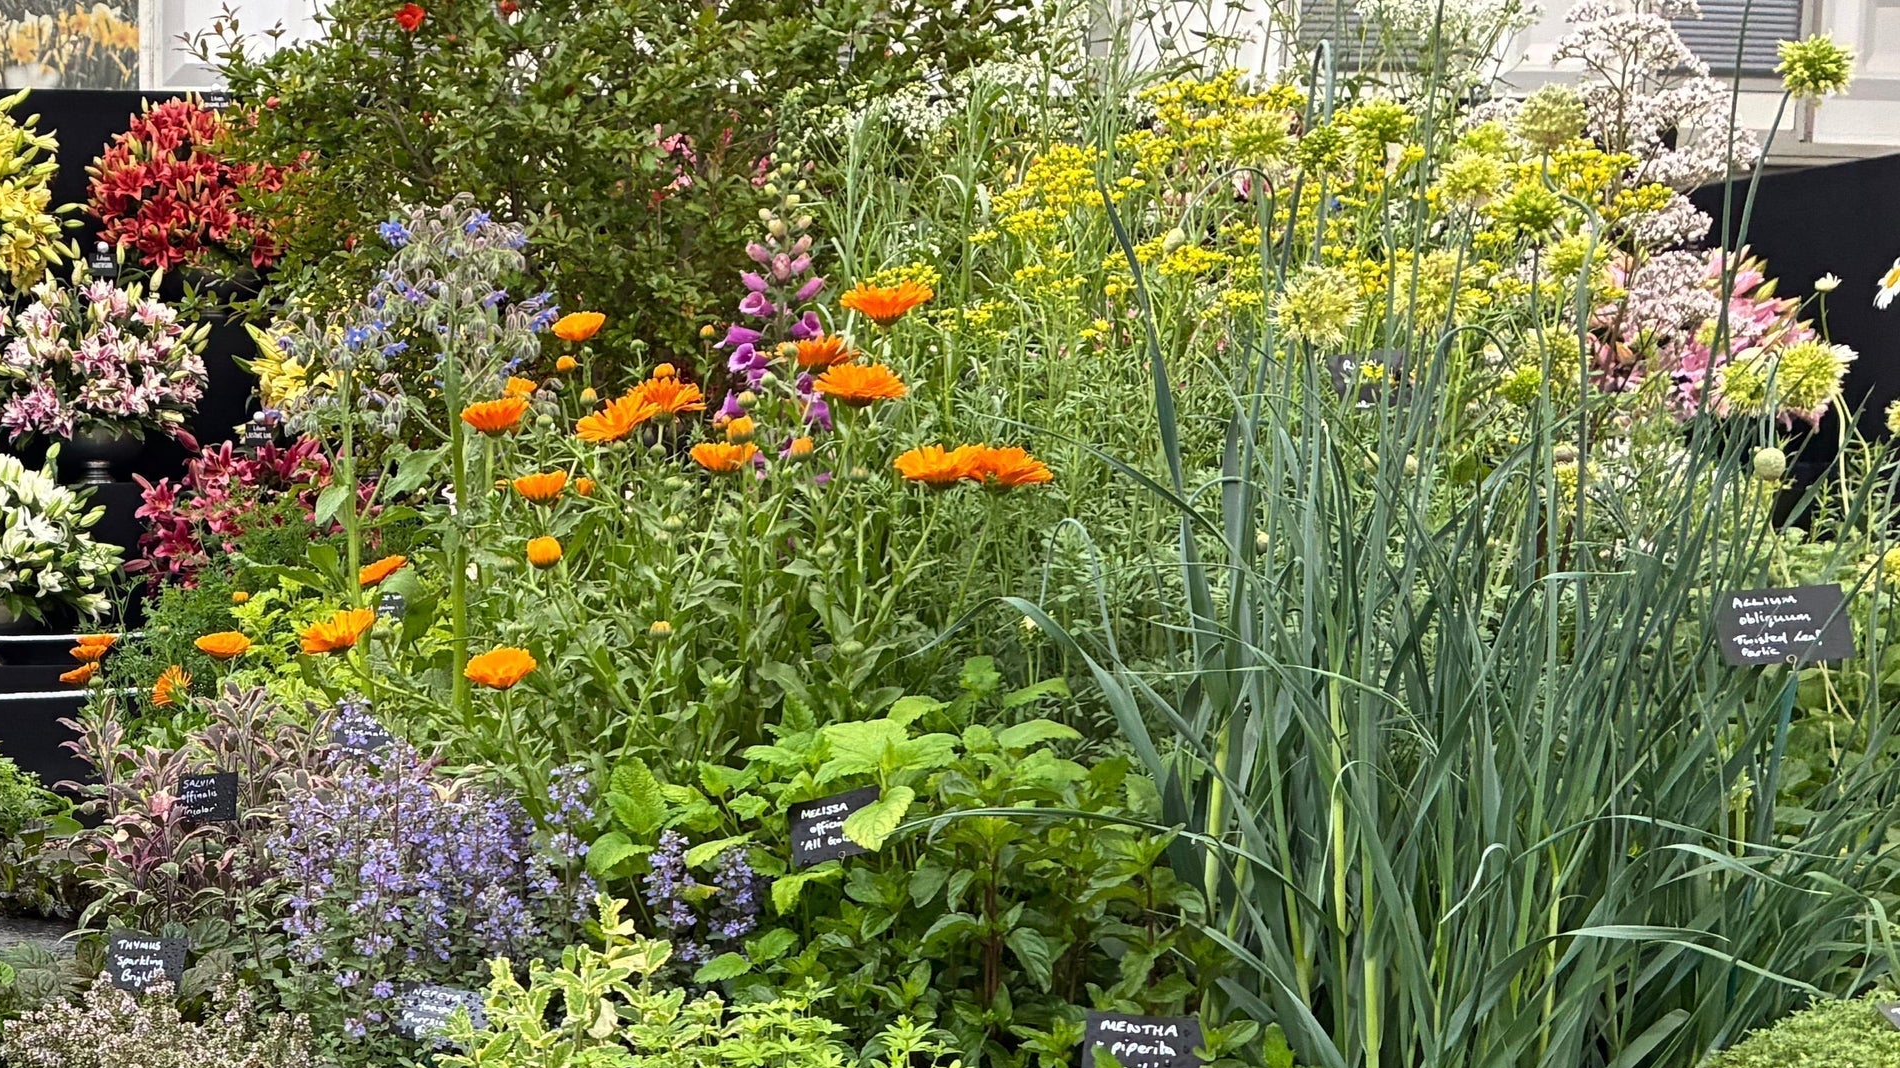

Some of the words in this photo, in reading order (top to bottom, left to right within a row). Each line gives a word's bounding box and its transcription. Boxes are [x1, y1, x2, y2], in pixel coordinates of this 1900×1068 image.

[183, 778, 215, 789] SALVIA
[801, 802, 848, 820] MELISSA
[117, 940, 162, 951] THYMUS
[1100, 1020, 1179, 1037] MENTHA
